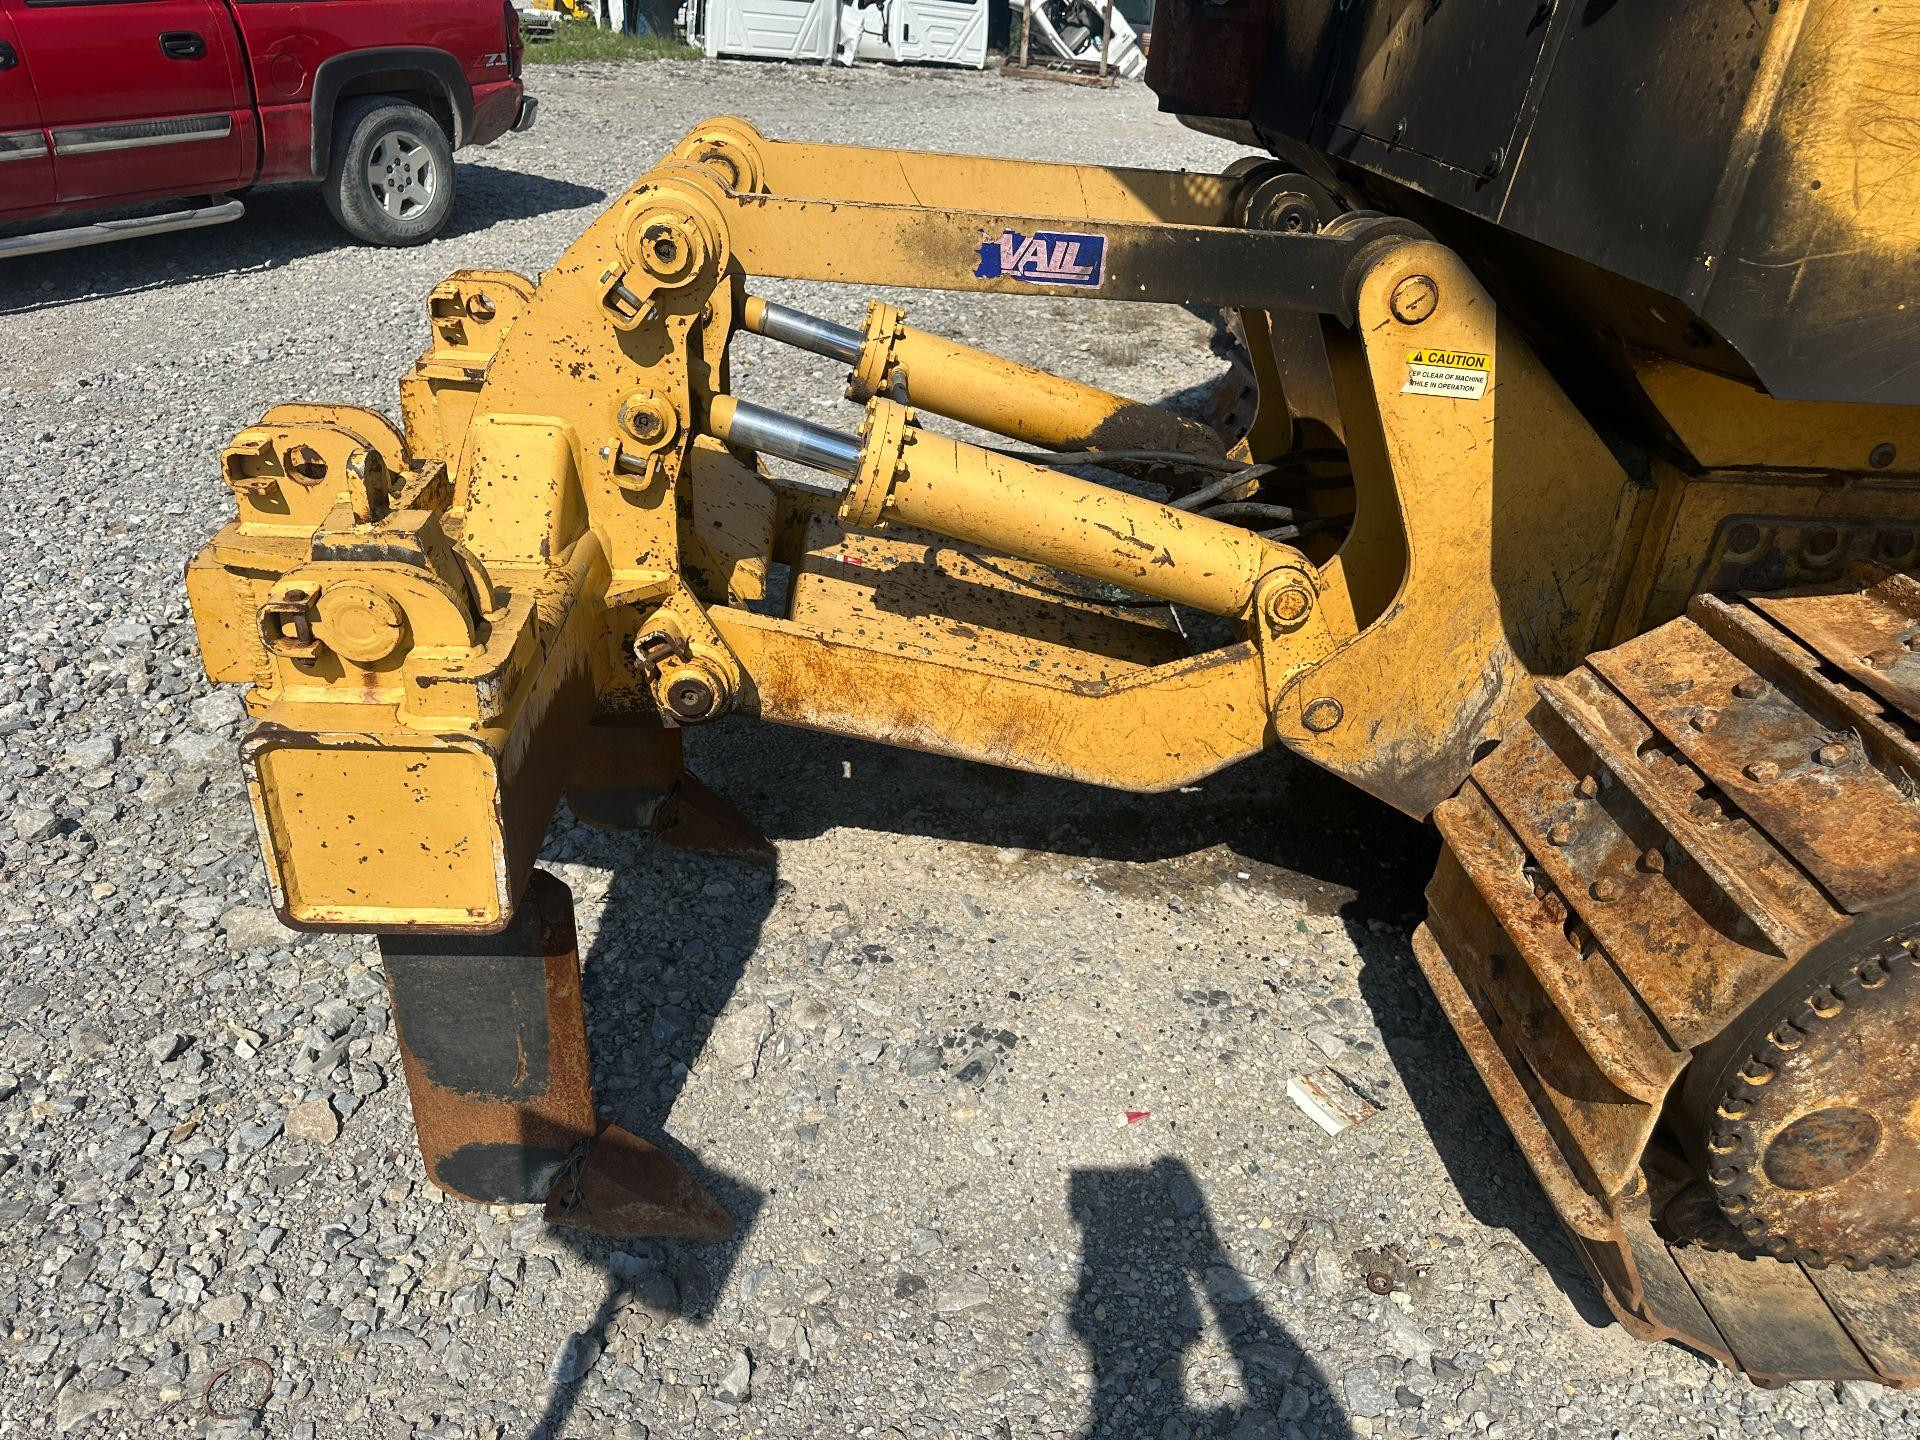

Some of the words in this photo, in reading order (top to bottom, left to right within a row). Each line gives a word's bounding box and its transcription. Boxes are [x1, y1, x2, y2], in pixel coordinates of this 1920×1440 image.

[472, 52, 507, 67] Z71
[1001, 234, 1094, 275] VAIL
[1428, 352, 1485, 368] CAUTION
[1422, 371, 1444, 379] CLEAR
[1455, 375, 1484, 383] MACHINE
[1438, 383, 1475, 392] OPERATION
